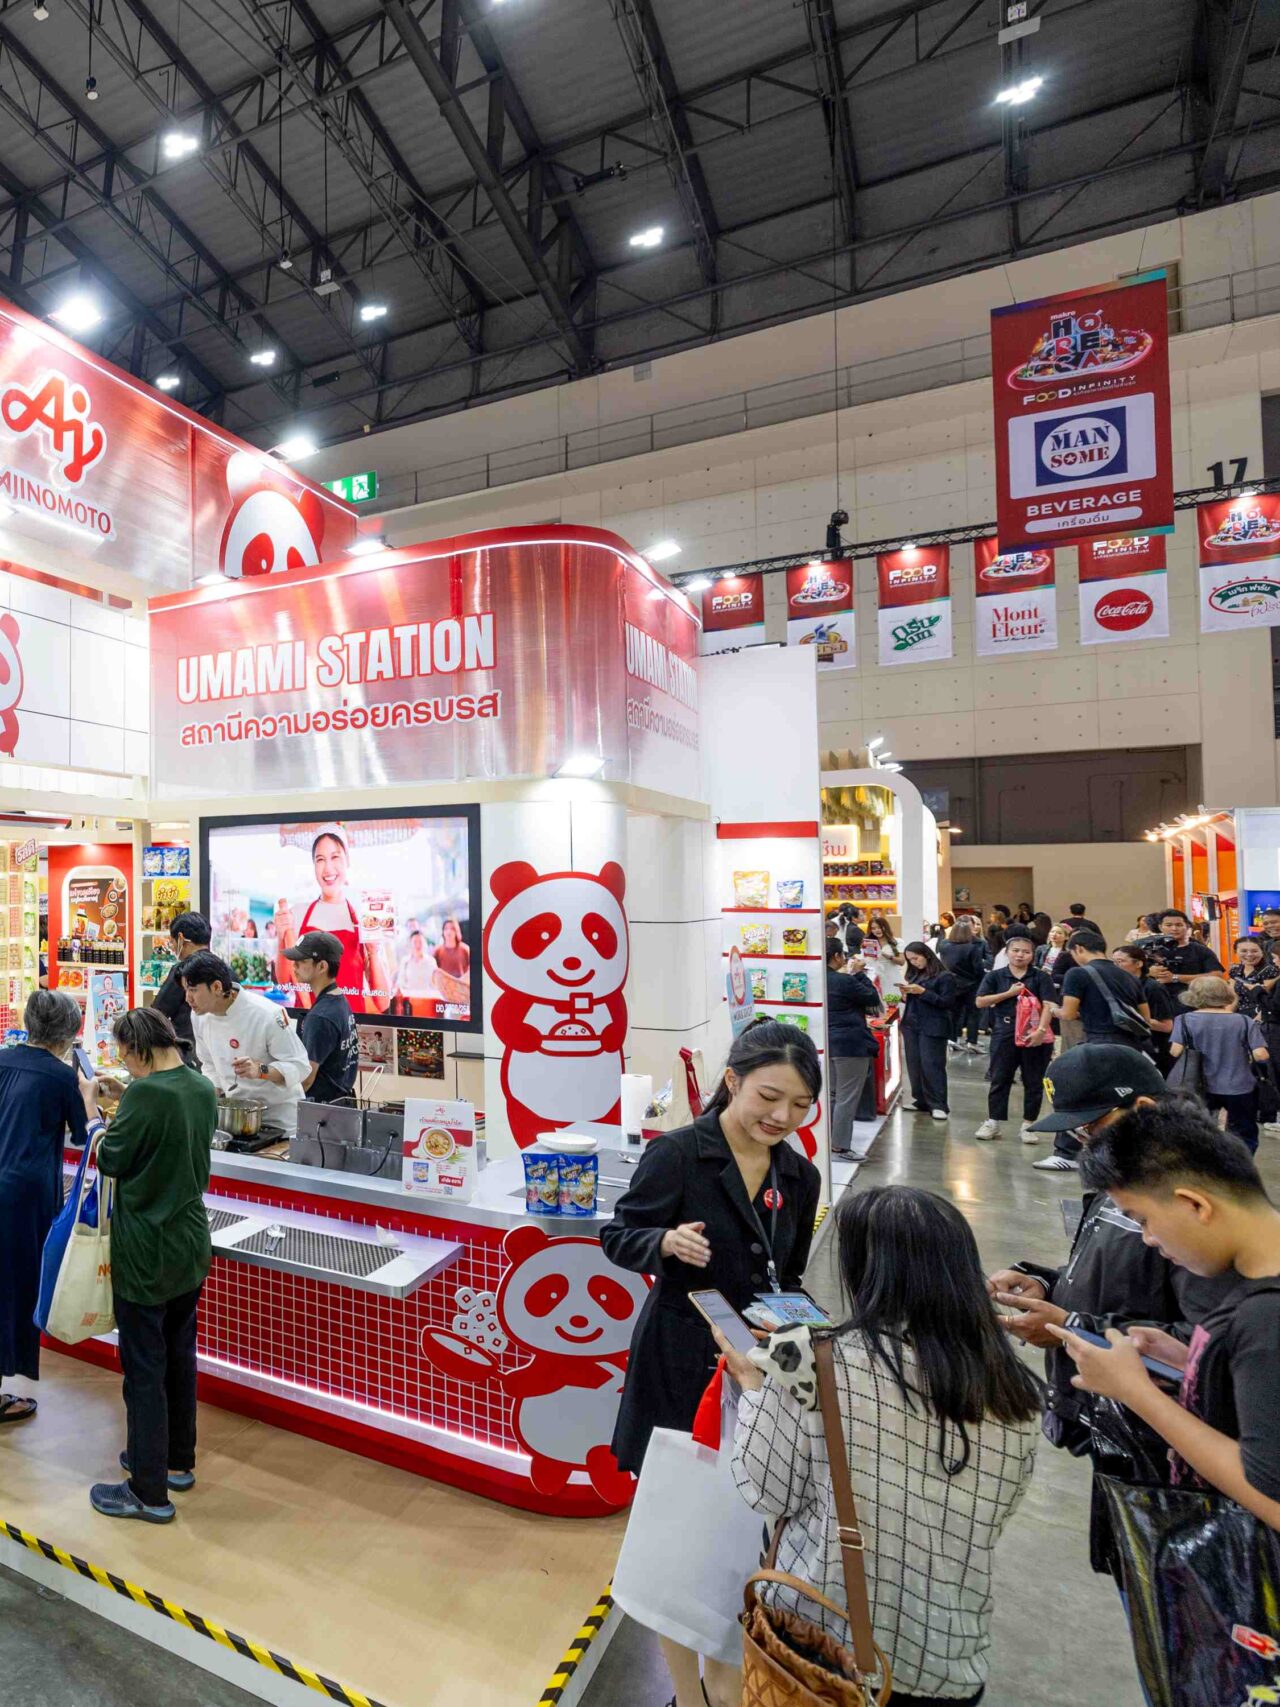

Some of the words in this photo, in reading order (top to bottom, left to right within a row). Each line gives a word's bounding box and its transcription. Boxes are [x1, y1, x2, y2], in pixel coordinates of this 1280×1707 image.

[1023, 388, 1072, 405] FOOD
[1073, 375, 1137, 392] INFINITY
[2, 376, 104, 483] Aj
[1051, 425, 1111, 452] MAN
[1050, 446, 1109, 469] SOME
[1207, 457, 1248, 491] 17
[1026, 489, 1141, 517] BEVERAGE
[1057, 512, 1109, 528] เครื่องดื่ม
[1092, 536, 1150, 551] FOOD
[1092, 545, 1149, 556] INFINITY
[889, 565, 937, 580] FOOD
[889, 574, 937, 585] INFINITY
[712, 592, 753, 606] FOOD
[712, 601, 753, 611] INFINITY
[992, 606, 1039, 622] Mont
[992, 622, 1040, 638] Fleur
[177, 640, 306, 704] UMAMI
[318, 613, 497, 687] STATION
[625, 620, 668, 694] UMAMI
[181, 692, 500, 747] สถานีความอร่อยครบรส
